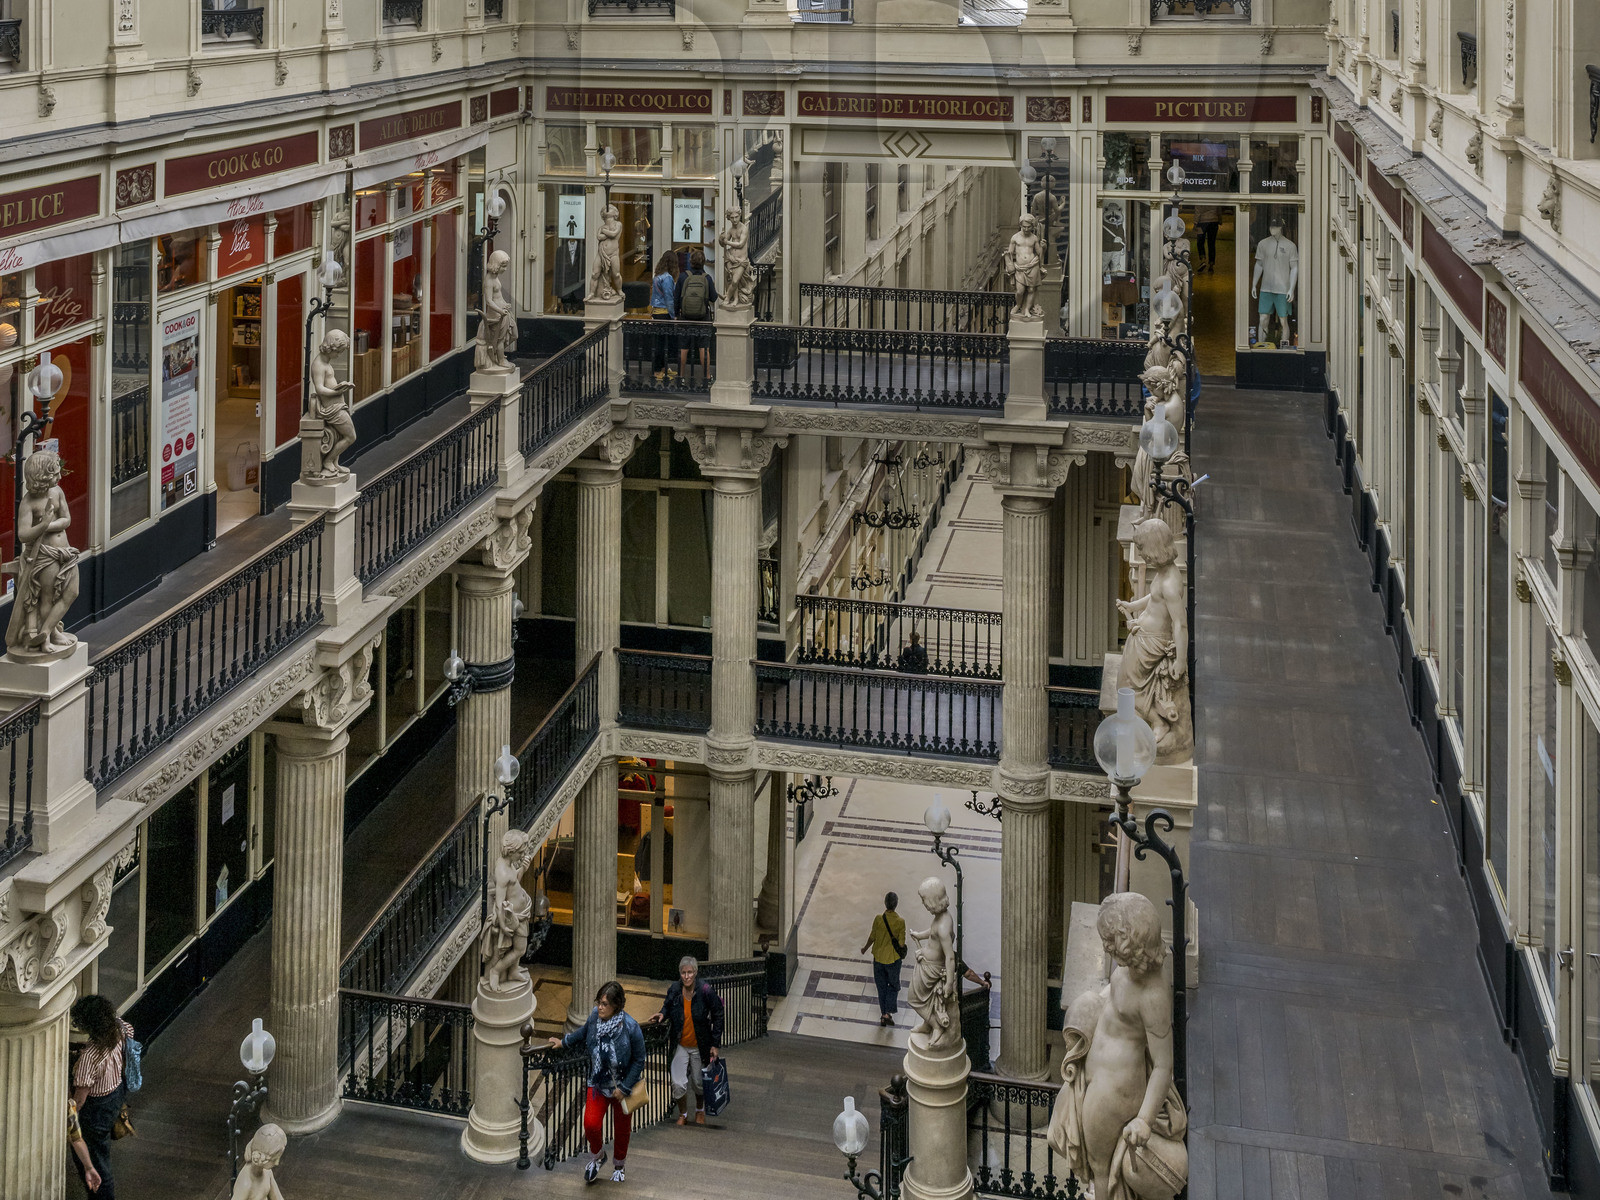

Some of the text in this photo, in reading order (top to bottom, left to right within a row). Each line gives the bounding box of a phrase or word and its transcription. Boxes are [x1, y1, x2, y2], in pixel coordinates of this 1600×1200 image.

[550, 92, 711, 110] ATELIER COQLICO
[801, 96, 877, 114] GALERIE
[881, 98, 904, 115] DE
[1155, 101, 1247, 118] PICTURE
[380, 110, 445, 141] ALICE DELICE
[208, 146, 283, 180] COOK & GO
[1261, 179, 1287, 188] SHARE
[0, 192, 65, 229] ELICE
[41, 286, 83, 316] Alice
